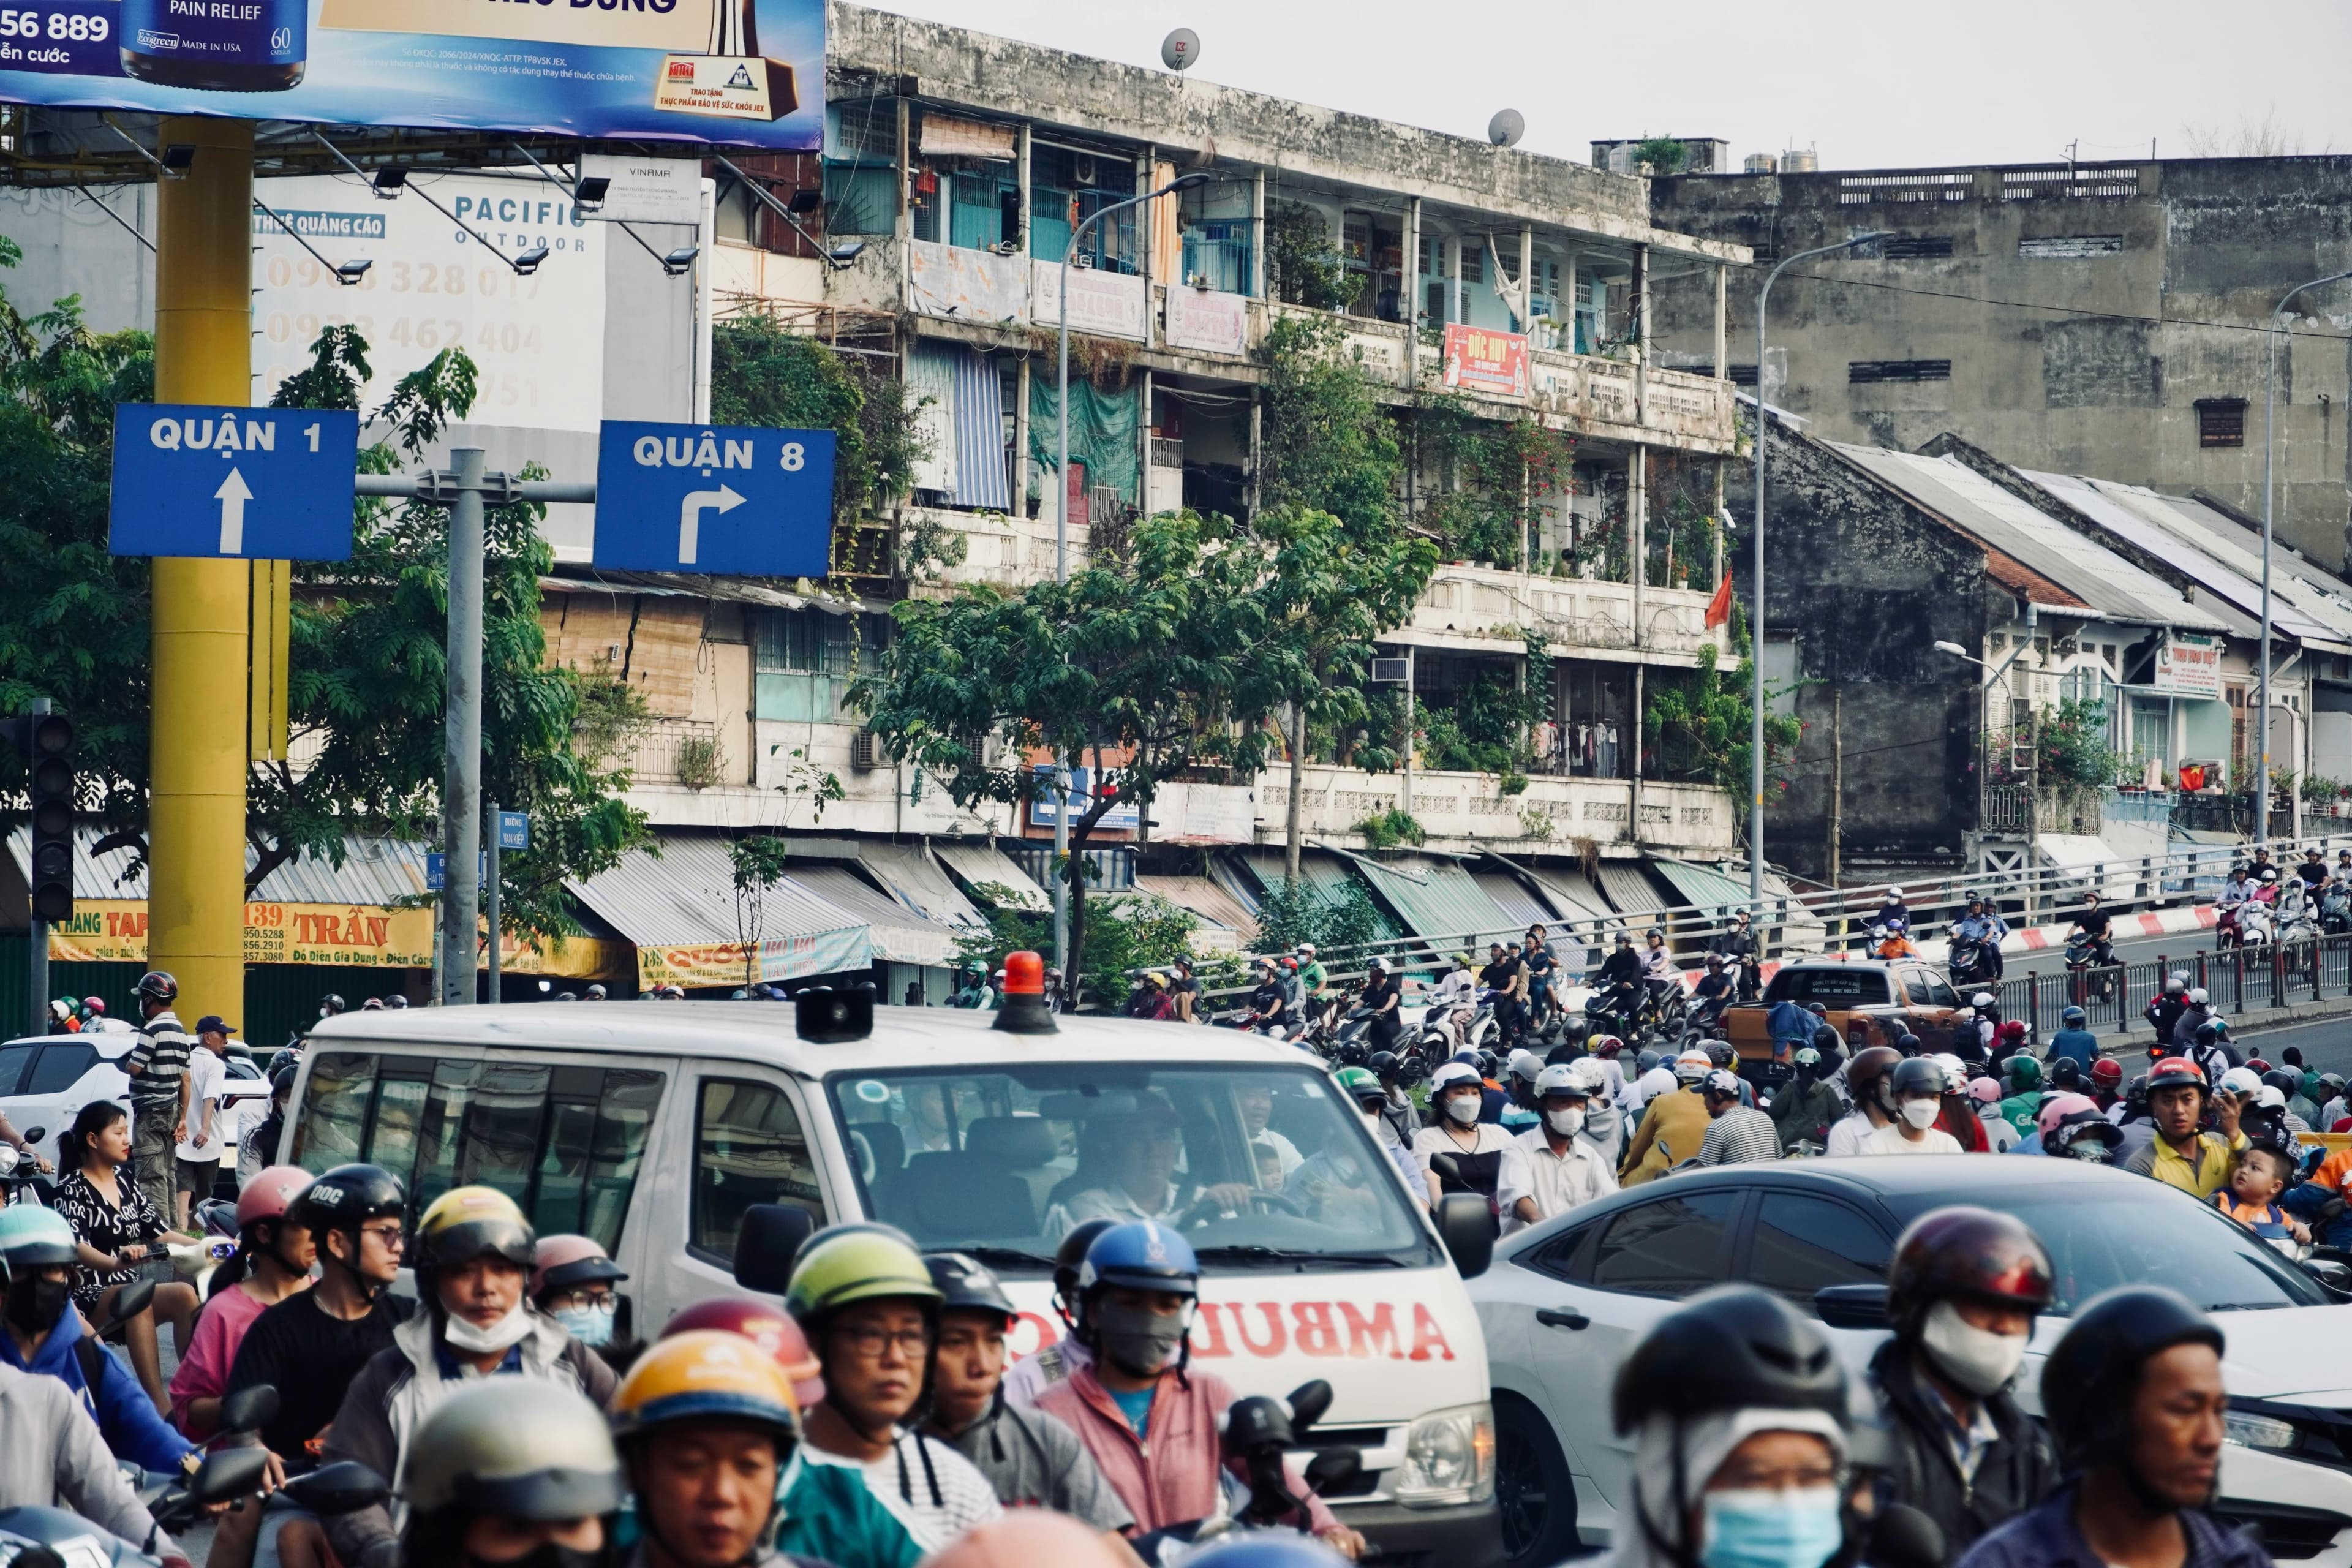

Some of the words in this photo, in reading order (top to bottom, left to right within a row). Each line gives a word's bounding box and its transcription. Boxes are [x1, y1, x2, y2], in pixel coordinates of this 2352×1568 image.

[170, 0, 205, 17] PAIN
[211, 3, 262, 20] RELIEF
[47, 13, 109, 42] 889
[270, 27, 291, 49] 60
[138, 31, 177, 48] Ecogreen
[181, 40, 206, 50] MADE
[223, 43, 241, 53] USA
[27, 47, 70, 63] cước
[441, 60, 462, 70] thuốc
[464, 62, 473, 71] và
[509, 65, 520, 74] tác
[522, 66, 541, 77] dụng
[543, 67, 559, 78] thay
[560, 68, 573, 78] thế
[575, 70, 595, 80] thuốc
[596, 72, 613, 80] chữa
[616, 72, 636, 82] bệnh.
[660, 97, 677, 107] THỰC
[678, 97, 697, 107] PHẨM
[698, 98, 711, 108] BẢO
[712, 100, 720, 110] VỆ
[722, 100, 734, 109] SỨC
[735, 101, 753, 111] KHỎE
[707, 89, 723, 98] TẶNG
[630, 168, 671, 178] VINAMA
[254, 213, 293, 231] THUÊ
[296, 213, 350, 234] QUẢNG
[353, 215, 382, 235] CÁO
[454, 230, 585, 252] OUTDOOR
[390, 260, 467, 296] 328
[1468, 330, 1487, 360] ĐỨC
[1488, 337, 1508, 363] HUY
[149, 412, 276, 459] QUẬN
[303, 422, 321, 453] 1
[632, 430, 753, 477] QUẬN
[779, 442, 805, 472] 8
[505, 816, 522, 827] ĐƯỜNG
[503, 832, 513, 846] VẠN
[513, 830, 524, 845] KIẾP
[429, 870, 437, 883] HẢI
[64, 905, 101, 933] HÀNG
[243, 904, 283, 927] 139
[293, 907, 391, 948] TRẦN
[96, 945, 113, 960] palan
[334, 951, 350, 963] Gia
[643, 950, 663, 968] 139
[667, 944, 758, 968] QUỐC
[764, 938, 788, 958] BO
[793, 935, 816, 955] BO
